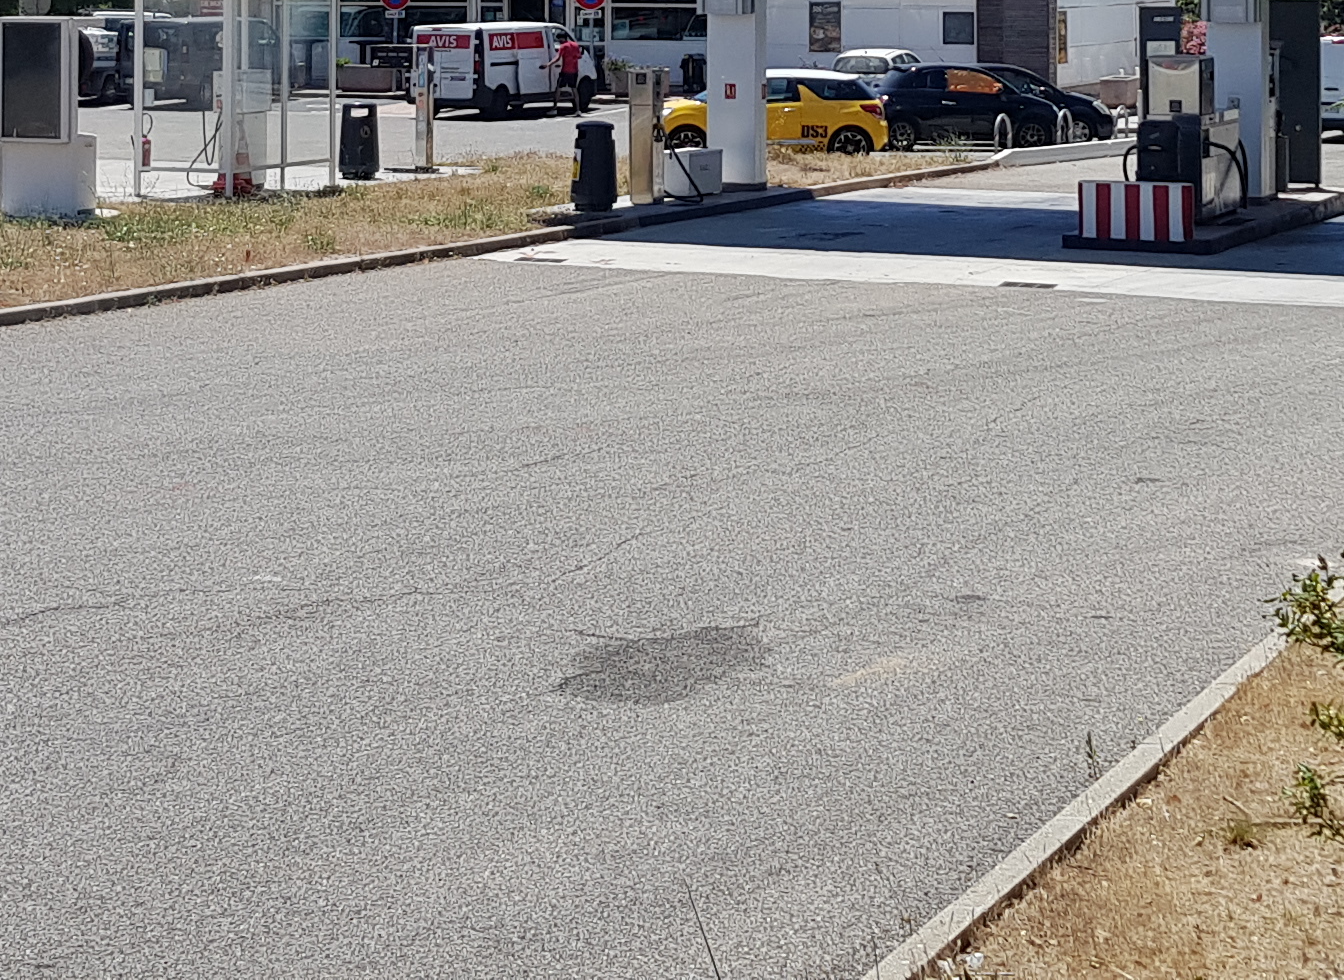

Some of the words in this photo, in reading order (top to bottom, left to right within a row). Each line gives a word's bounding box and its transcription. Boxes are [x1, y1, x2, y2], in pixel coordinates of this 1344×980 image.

[429, 35, 457, 48] AVIS
[492, 34, 513, 49] AVIS
[801, 124, 828, 138] DS3
